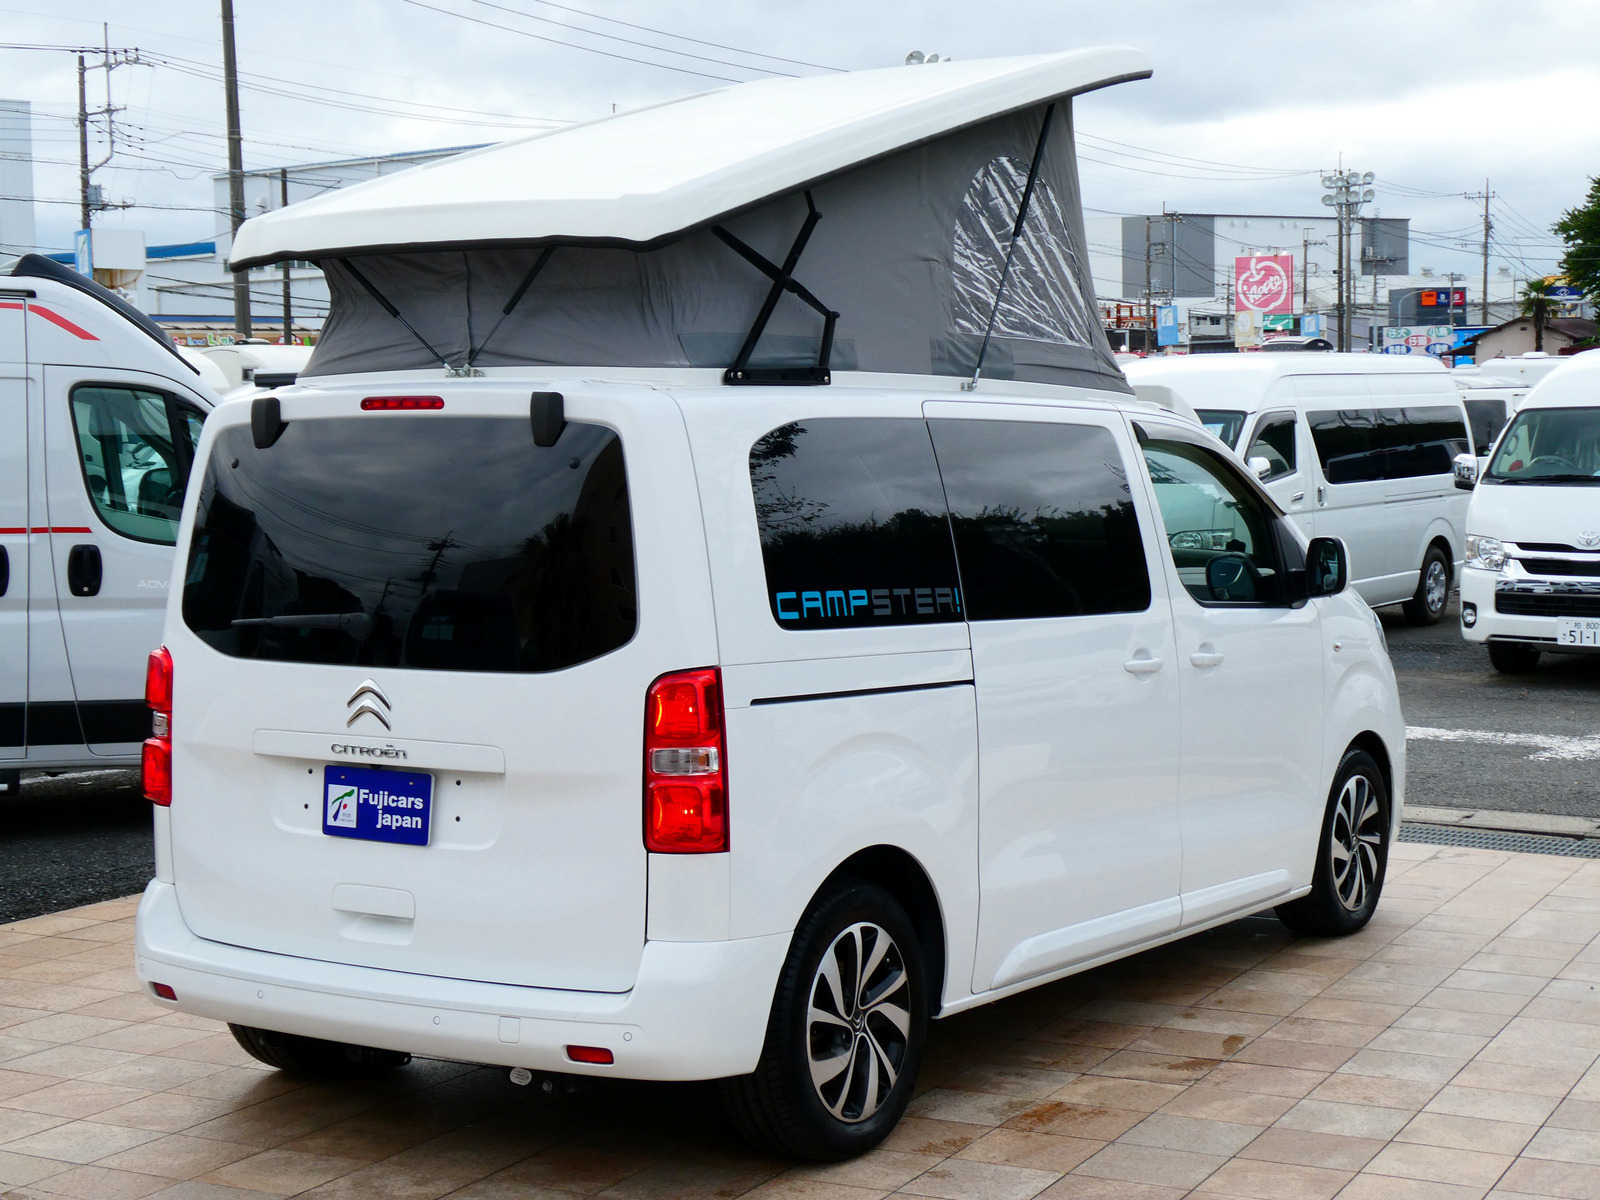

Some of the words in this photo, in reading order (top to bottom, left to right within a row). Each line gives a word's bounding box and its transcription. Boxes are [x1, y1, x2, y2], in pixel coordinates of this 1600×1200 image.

[207, 332, 235, 346] Link
[776, 587, 961, 620] CAMPSTER!
[359, 788, 424, 810] Fujicars
[376, 810, 422, 830] japan
